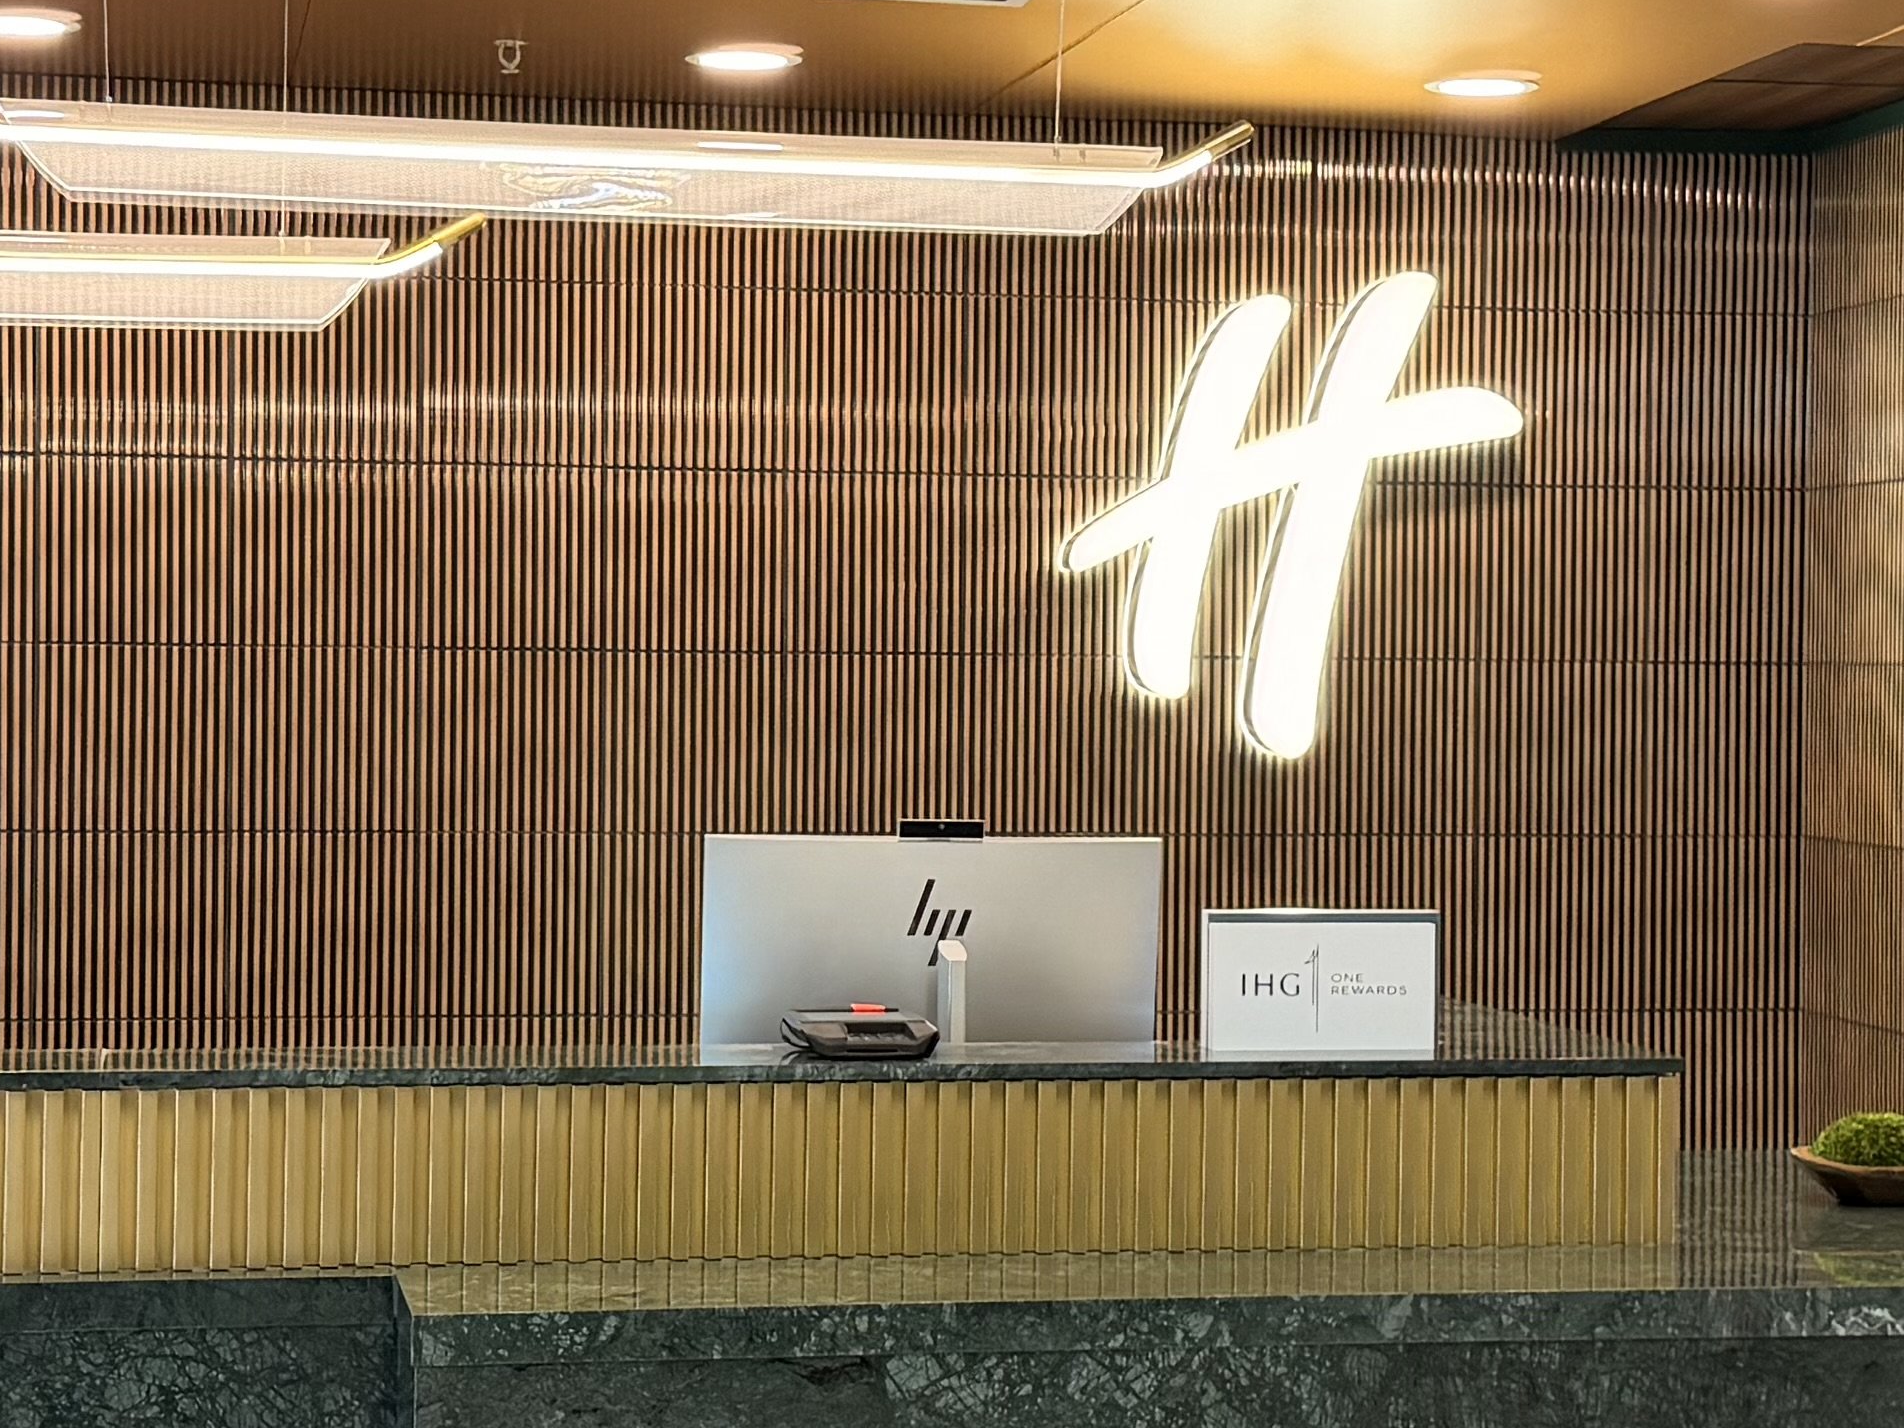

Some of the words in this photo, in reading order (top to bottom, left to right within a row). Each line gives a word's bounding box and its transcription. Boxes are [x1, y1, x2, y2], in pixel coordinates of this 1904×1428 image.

[1058, 270, 1524, 760] H
[907, 879, 972, 966] hp
[1241, 973, 1300, 997] IHG
[1330, 973, 1364, 983] ONE
[1330, 985, 1407, 996] REWARDS
